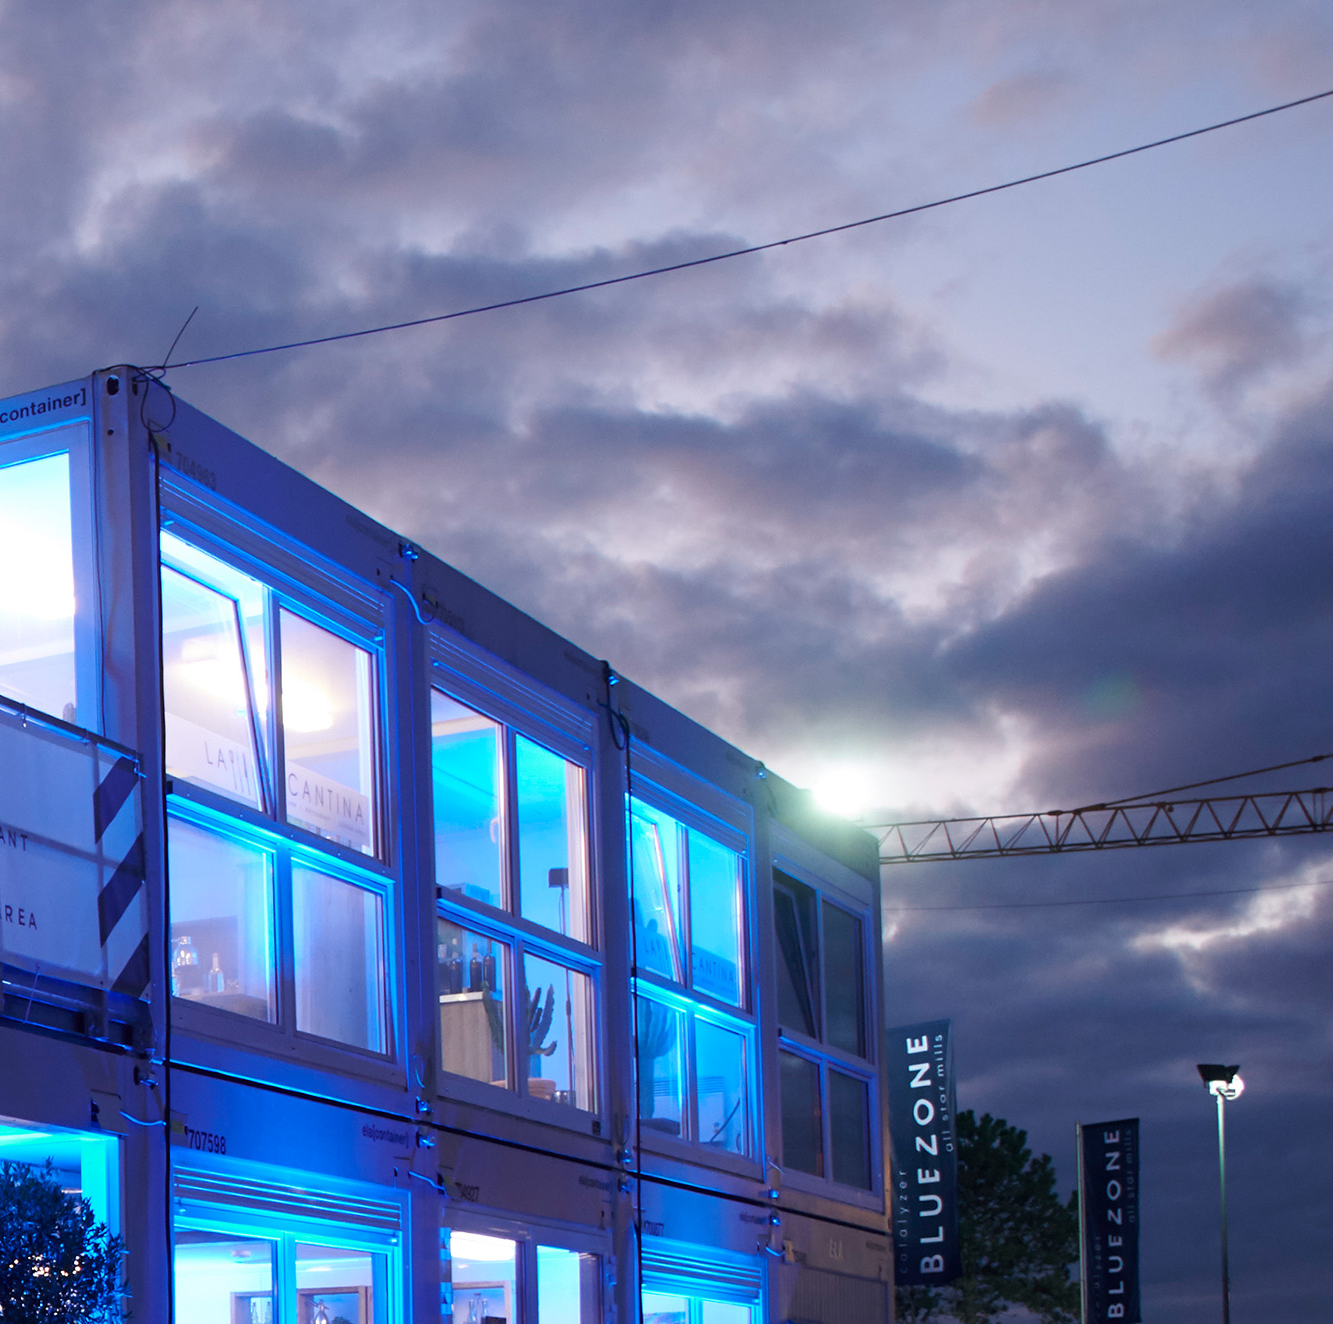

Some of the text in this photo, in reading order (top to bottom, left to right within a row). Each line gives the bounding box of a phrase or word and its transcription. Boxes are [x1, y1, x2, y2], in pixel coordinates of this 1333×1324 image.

[288, 773, 365, 824] CANTINA
[933, 1034, 944, 1078] mills
[188, 1129, 227, 1155] 707598
[906, 1034, 945, 1275] BLUEZONE
[942, 1130, 954, 1153] all
[1103, 1129, 1125, 1318] BLUEZONE
